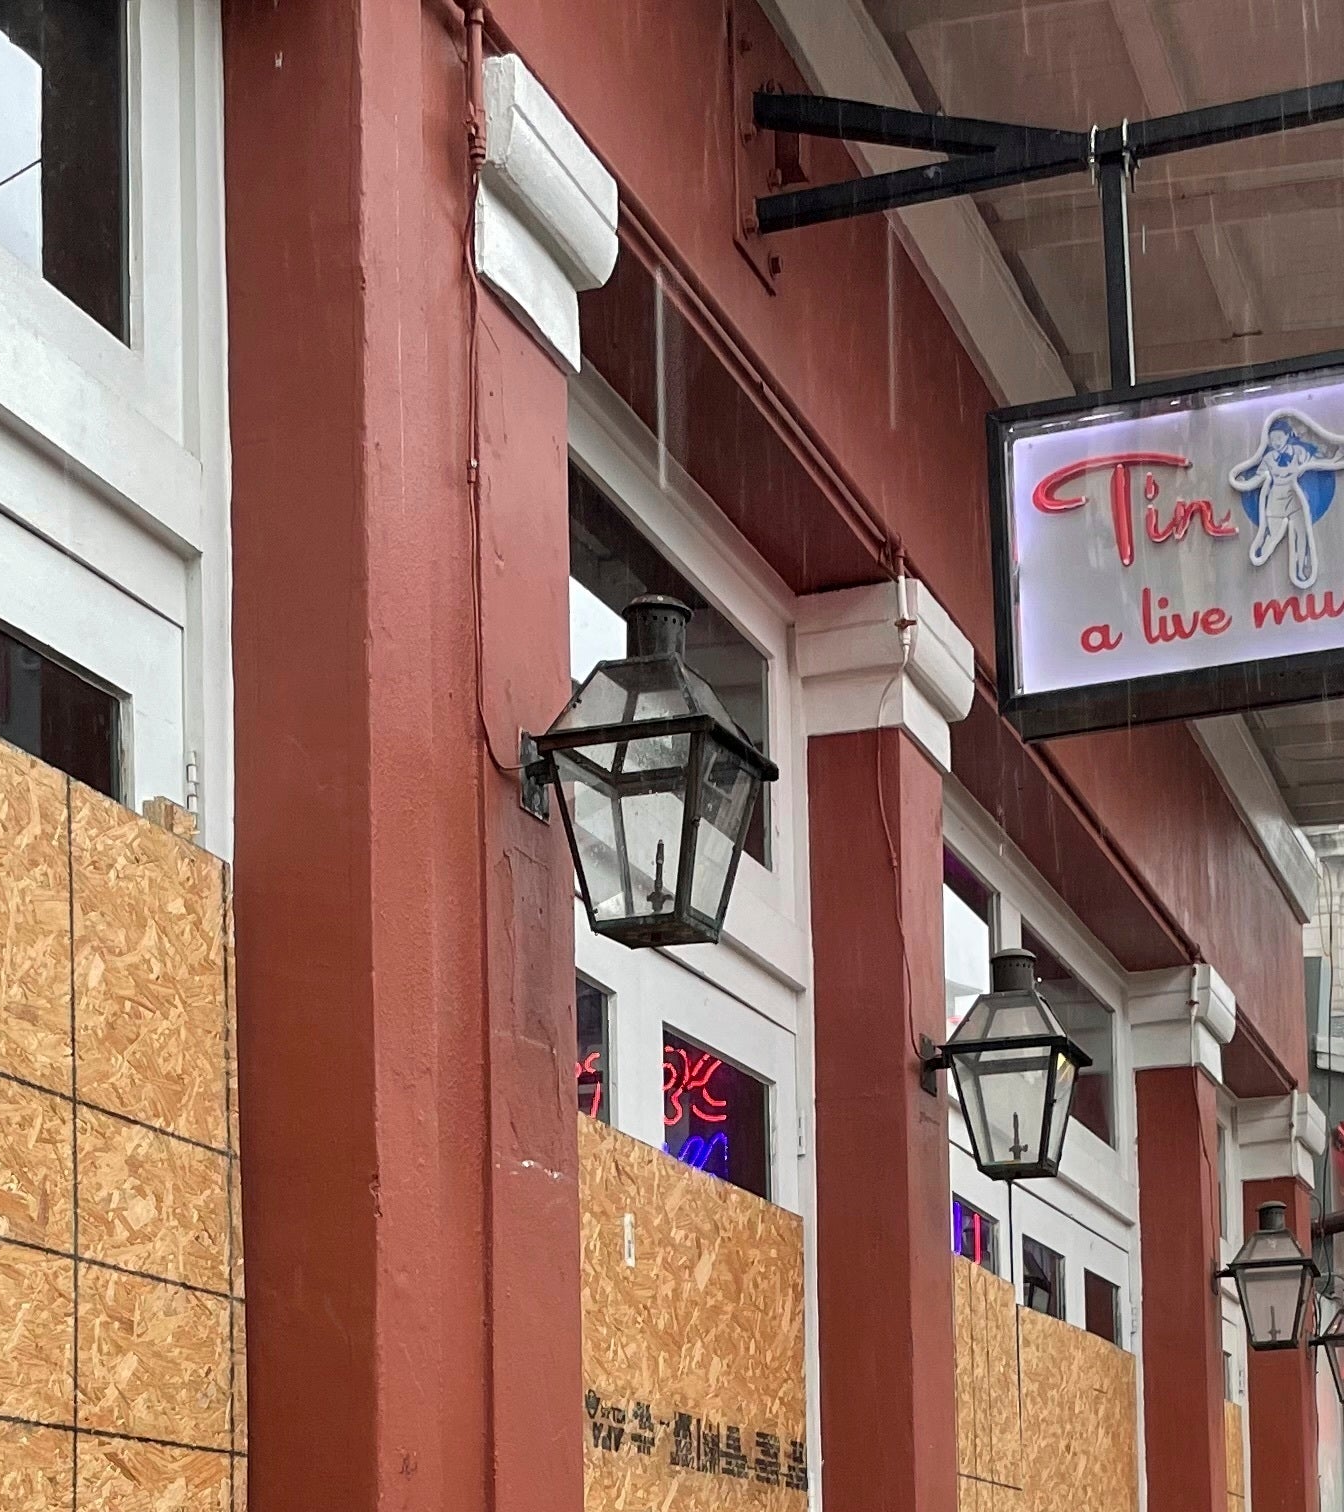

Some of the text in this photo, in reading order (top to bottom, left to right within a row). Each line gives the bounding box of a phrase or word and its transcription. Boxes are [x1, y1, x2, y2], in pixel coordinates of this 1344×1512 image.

[1032, 451, 1239, 567] Tin
[1080, 623, 1123, 653] a
[1142, 587, 1233, 645] live
